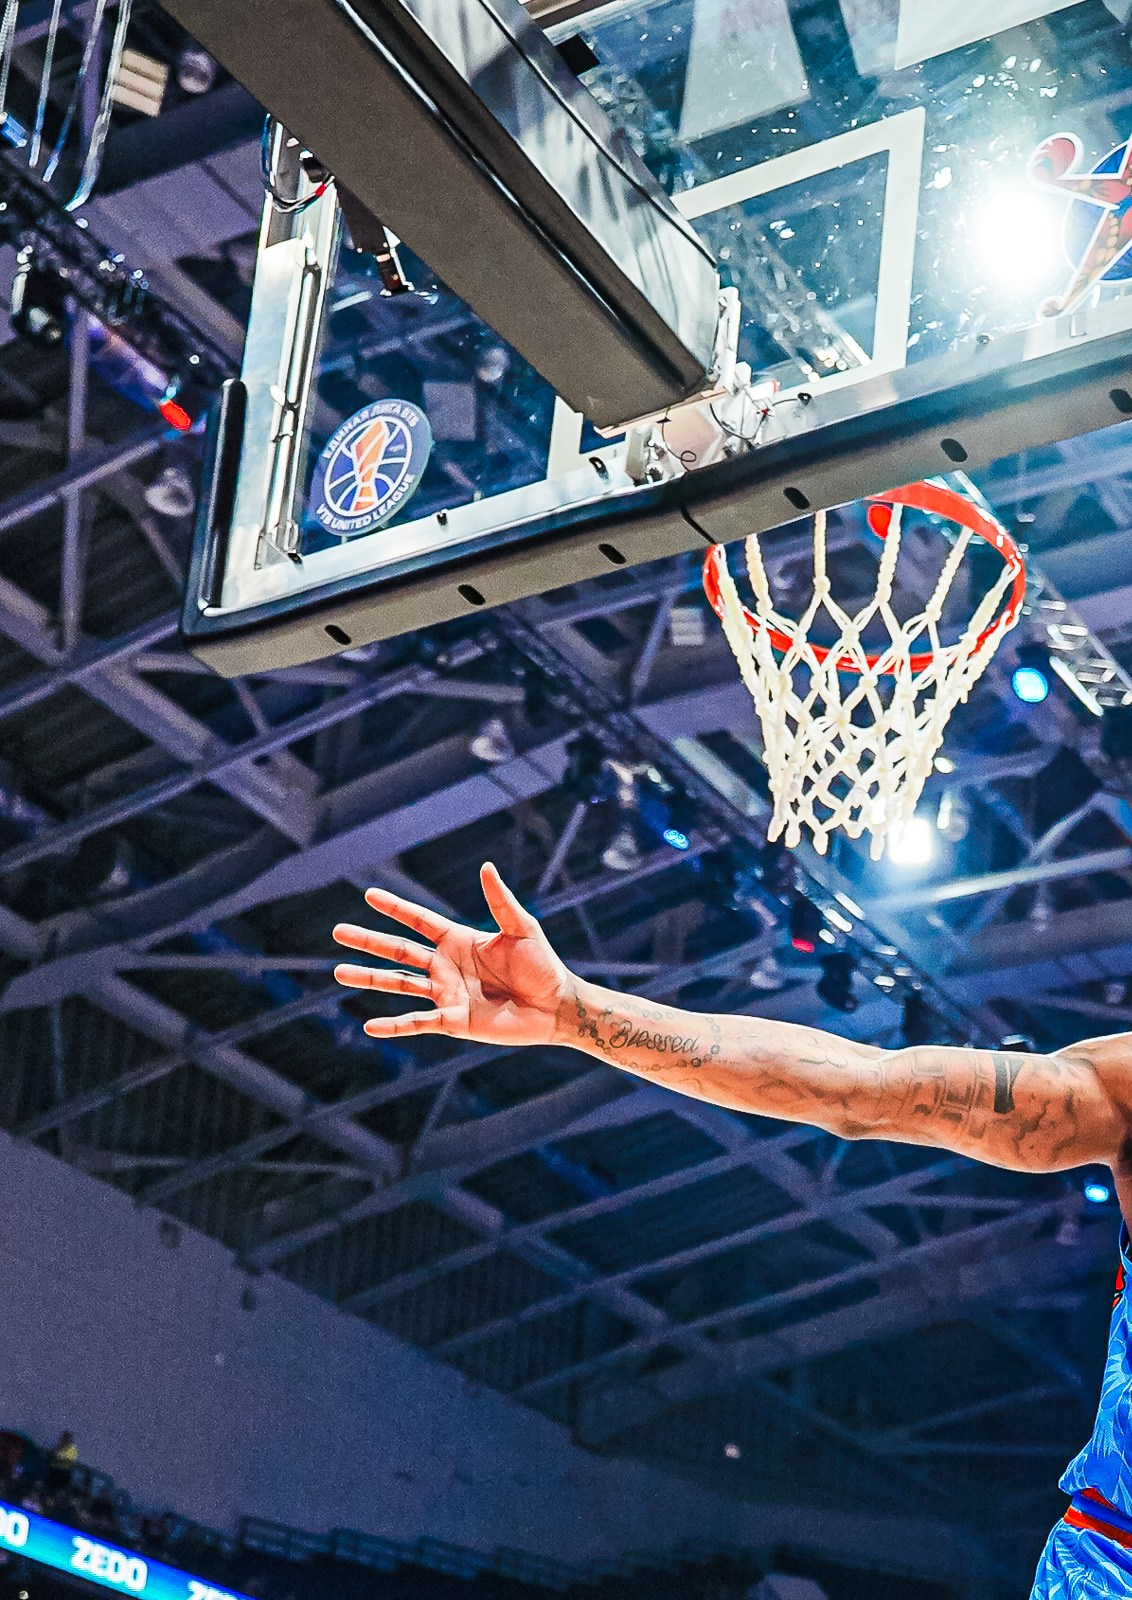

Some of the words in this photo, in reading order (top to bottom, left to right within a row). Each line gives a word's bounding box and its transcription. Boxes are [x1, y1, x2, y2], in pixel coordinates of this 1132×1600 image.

[331, 515, 372, 531] UNITED
[372, 473, 415, 520] LEAGUE
[71, 1536, 147, 1591] ZEDO
